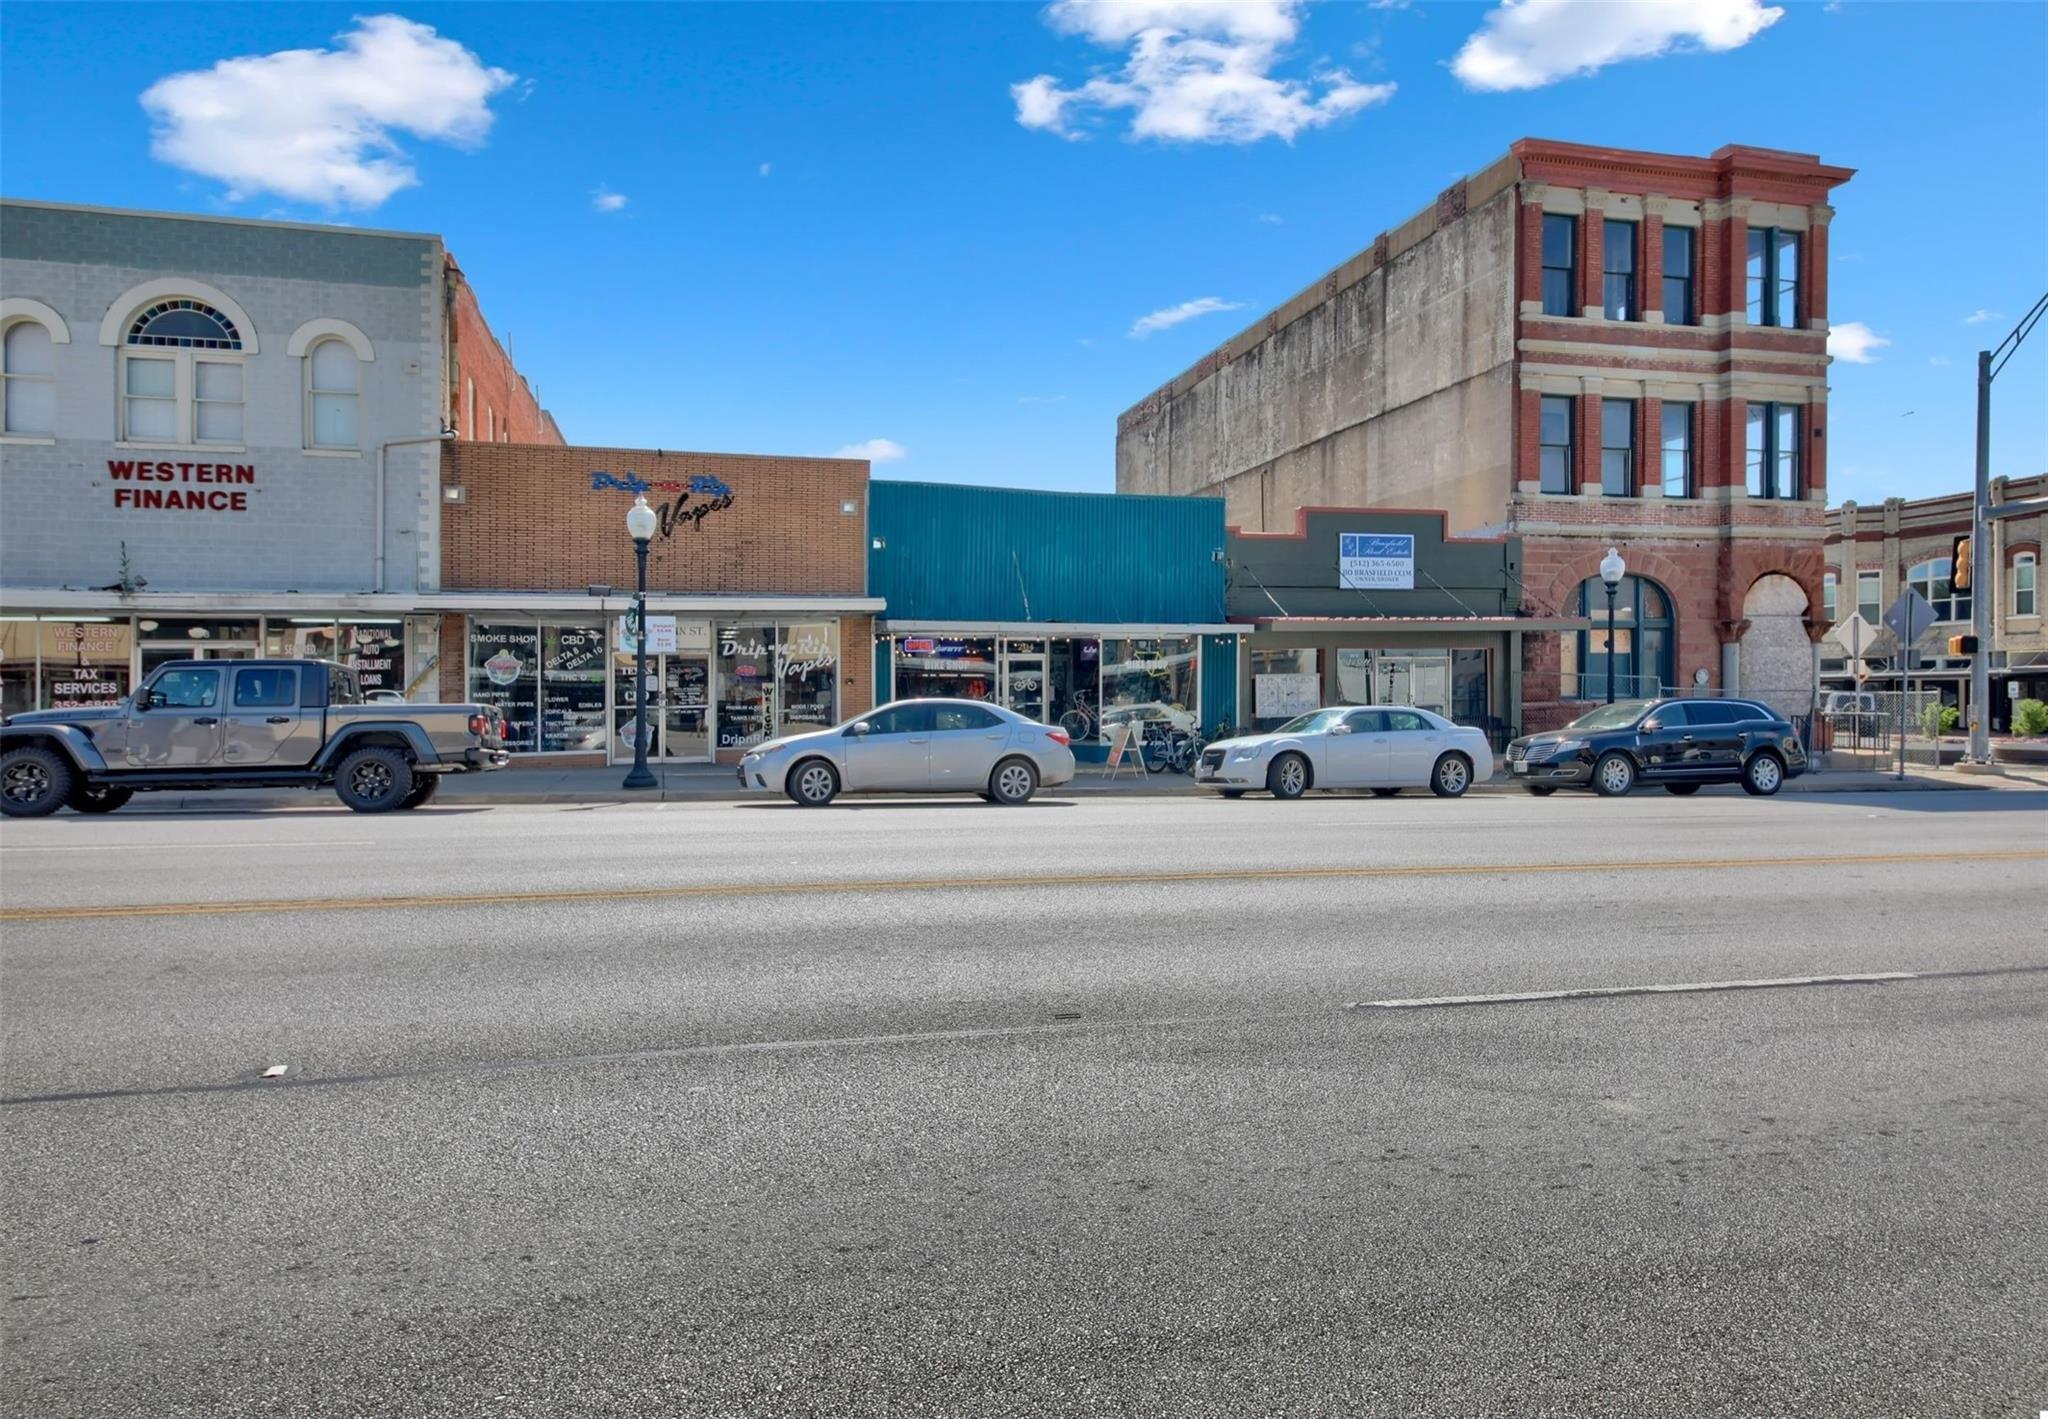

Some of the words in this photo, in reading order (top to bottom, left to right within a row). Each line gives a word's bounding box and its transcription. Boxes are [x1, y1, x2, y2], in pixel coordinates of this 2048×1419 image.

[107, 460, 254, 484] WESTERN
[114, 489, 247, 510] FINANCE
[656, 492, 735, 537] Vapes
[54, 627, 118, 638] WESTERN
[470, 634, 507, 644] SMOKE
[509, 635, 537, 644] SHOP
[561, 635, 585, 645] CBD
[58, 642, 113, 652] FINANCE
[362, 645, 379, 655] AUTO
[81, 656, 90, 666] &
[546, 650, 574, 668] DELTA
[566, 652, 593, 670] DELTA
[593, 647, 602, 656] 10
[776, 656, 836, 682] Vapes
[924, 660, 944, 670] BIKE
[73, 668, 98, 680] TAX
[360, 674, 382, 685] LOANS
[54, 683, 118, 694] SERVICES
